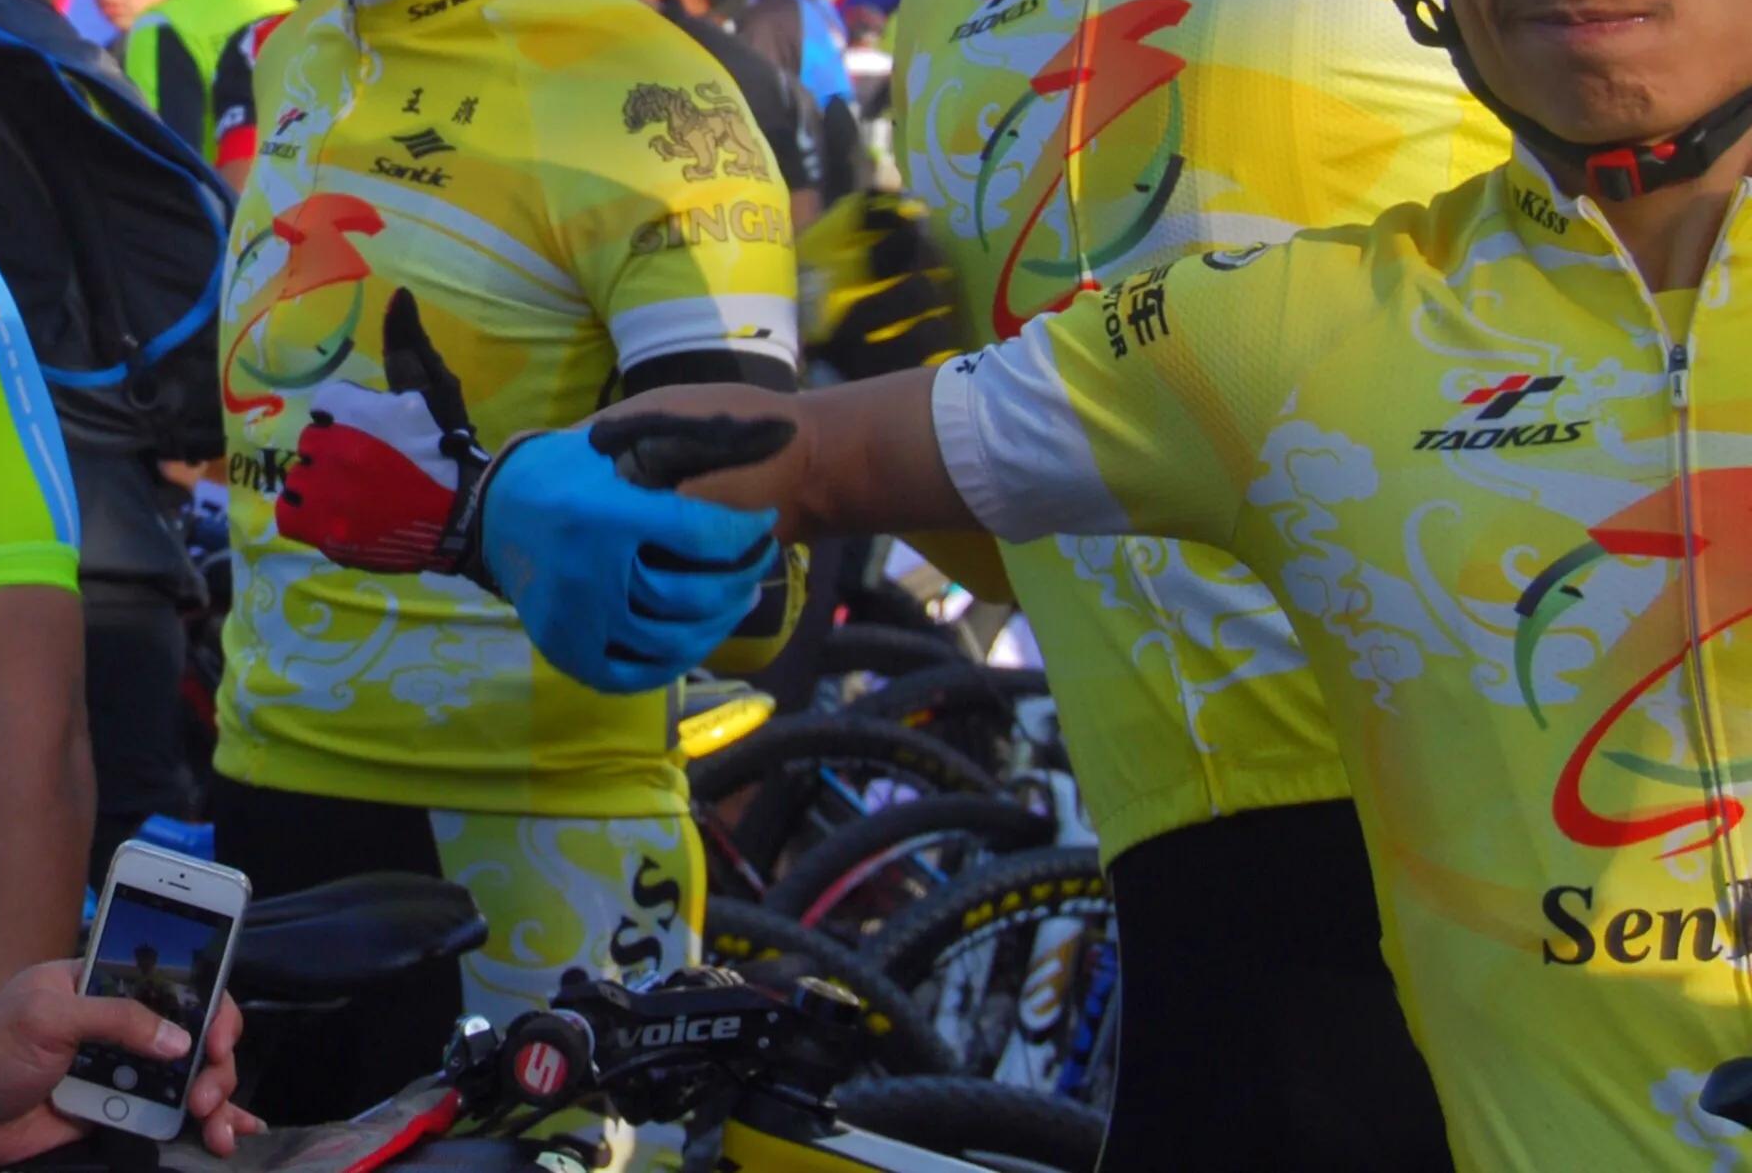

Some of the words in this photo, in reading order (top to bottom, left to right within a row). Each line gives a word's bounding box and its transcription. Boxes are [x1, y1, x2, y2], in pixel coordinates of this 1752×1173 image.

[369, 156, 454, 189] Santic
[1412, 420, 1592, 451] TAOKAS
[614, 1014, 742, 1049] voice
